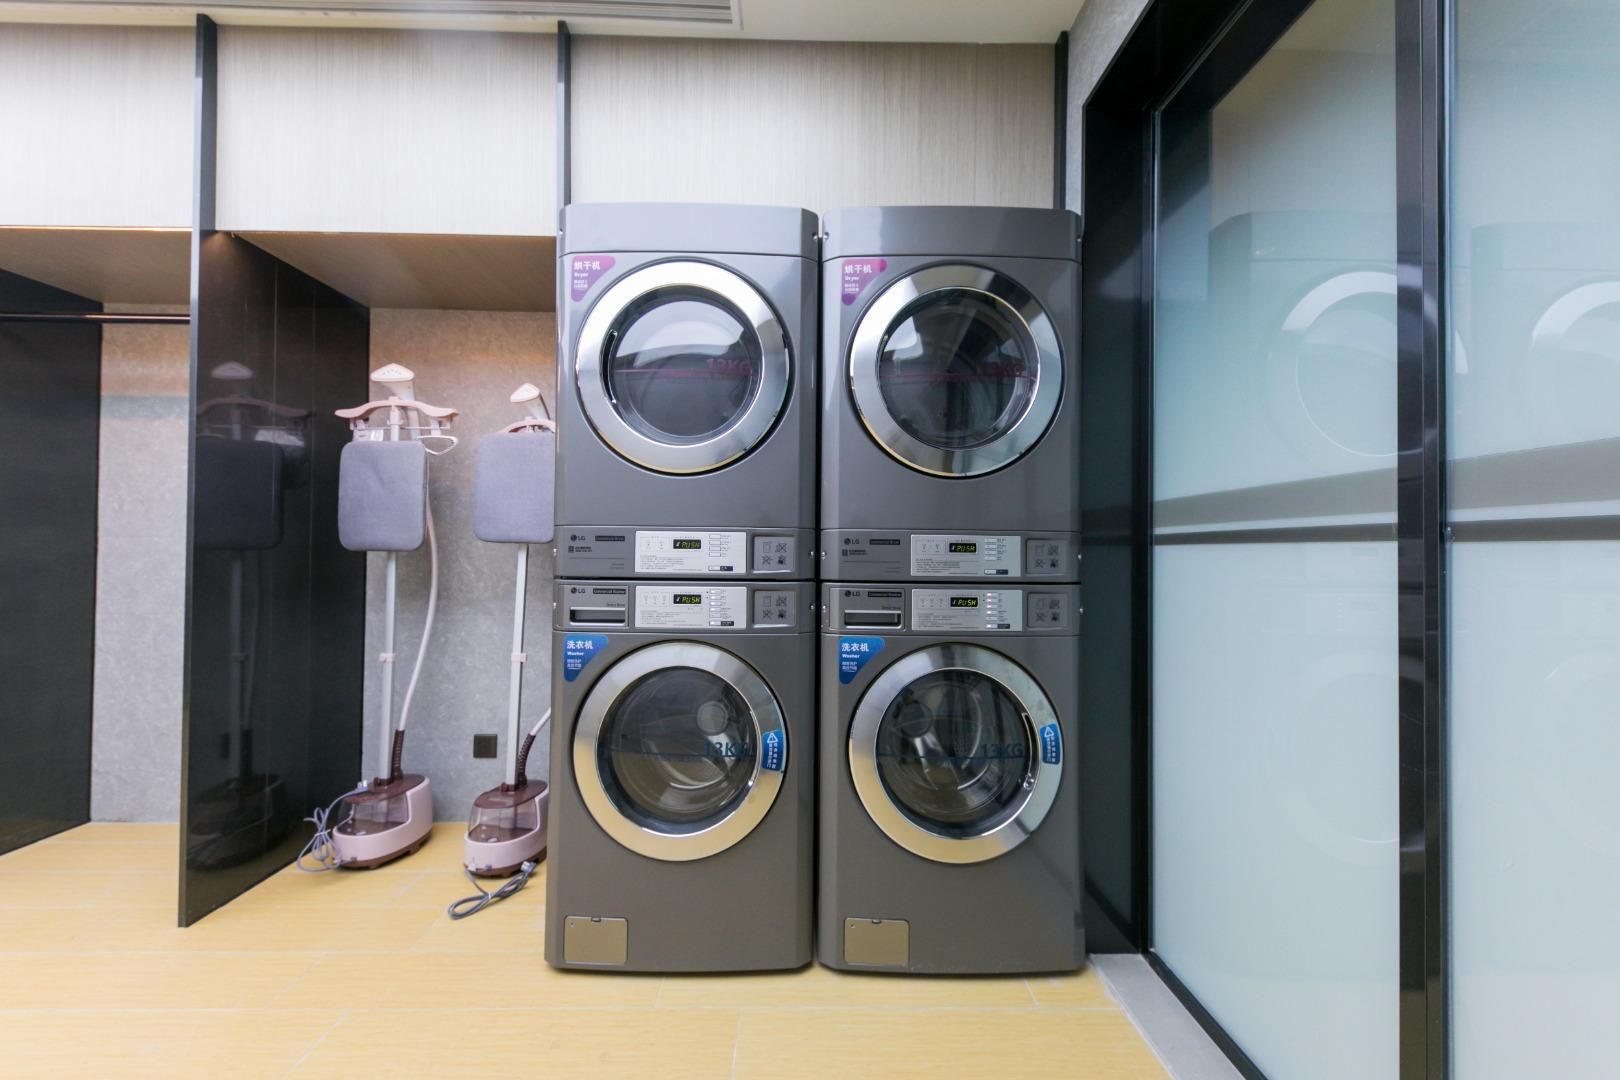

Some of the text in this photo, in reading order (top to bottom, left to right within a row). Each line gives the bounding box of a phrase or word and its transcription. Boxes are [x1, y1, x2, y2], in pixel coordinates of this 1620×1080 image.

[958, 598, 976, 606] PUSH
[567, 640, 593, 649] 洗衣机
[841, 643, 869, 652] 洗衣机
